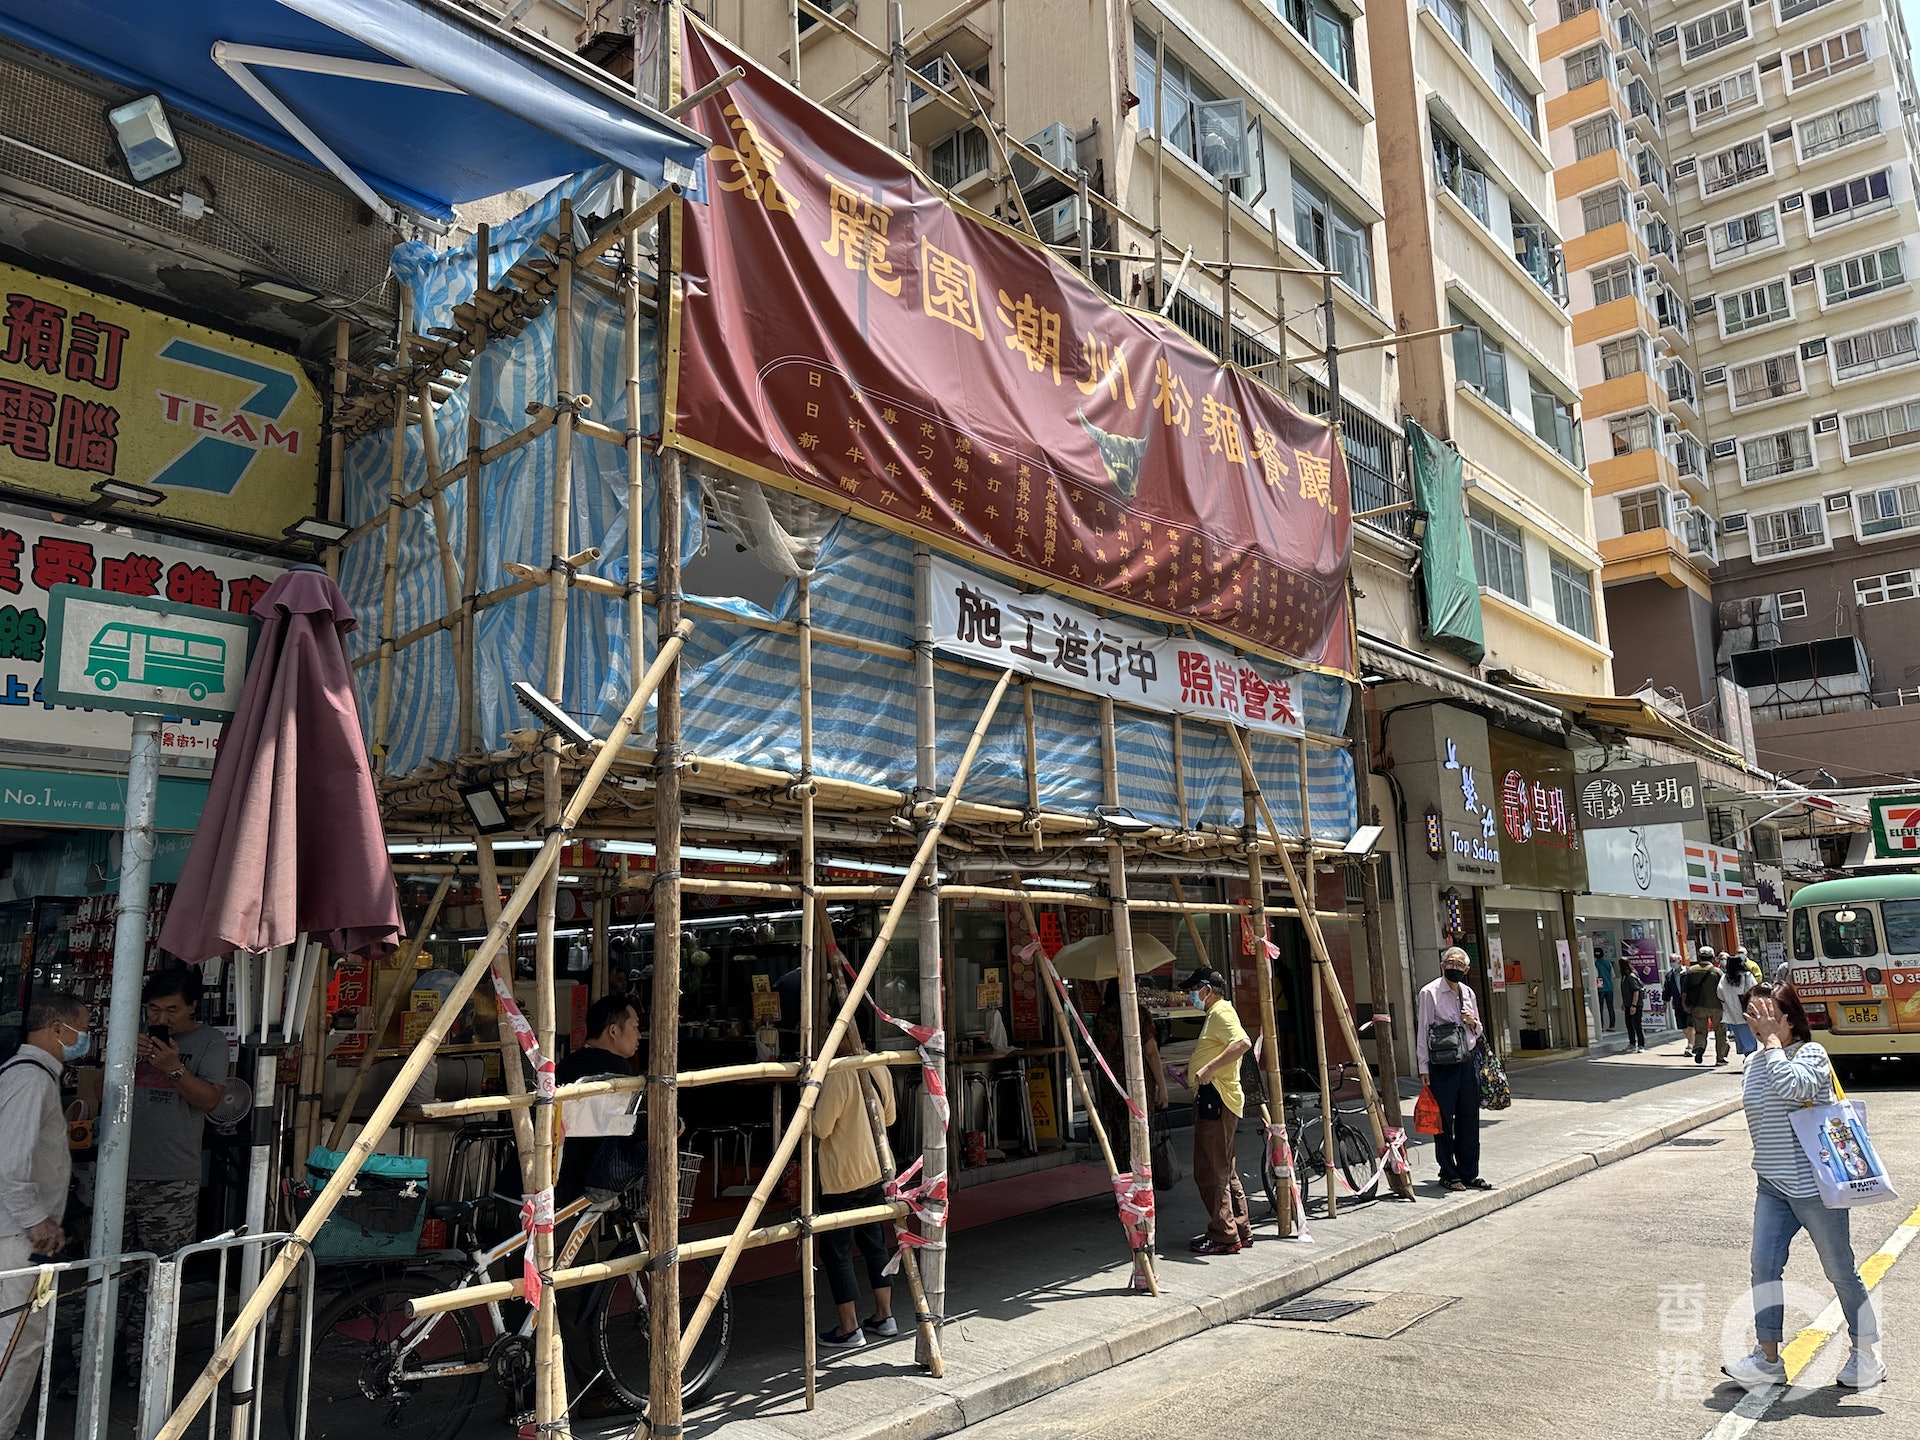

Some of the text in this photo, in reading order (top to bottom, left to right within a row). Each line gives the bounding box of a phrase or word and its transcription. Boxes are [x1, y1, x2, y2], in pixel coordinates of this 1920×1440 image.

[2, 294, 129, 391] 預訂
[160, 392, 299, 455] TEAM
[982, 451, 1002, 548] 手打牛丸
[1069, 489, 1084, 578] 手打魚丸
[954, 581, 1296, 726] 施工進行中 照常營業
[3, 787, 51, 807] No.1
[53, 799, 82, 809] Wi-Fi
[1451, 830, 1500, 864] Top Salon
[1793, 966, 1862, 985] 明愛毅進
[1848, 1014, 1878, 1023] 2663
